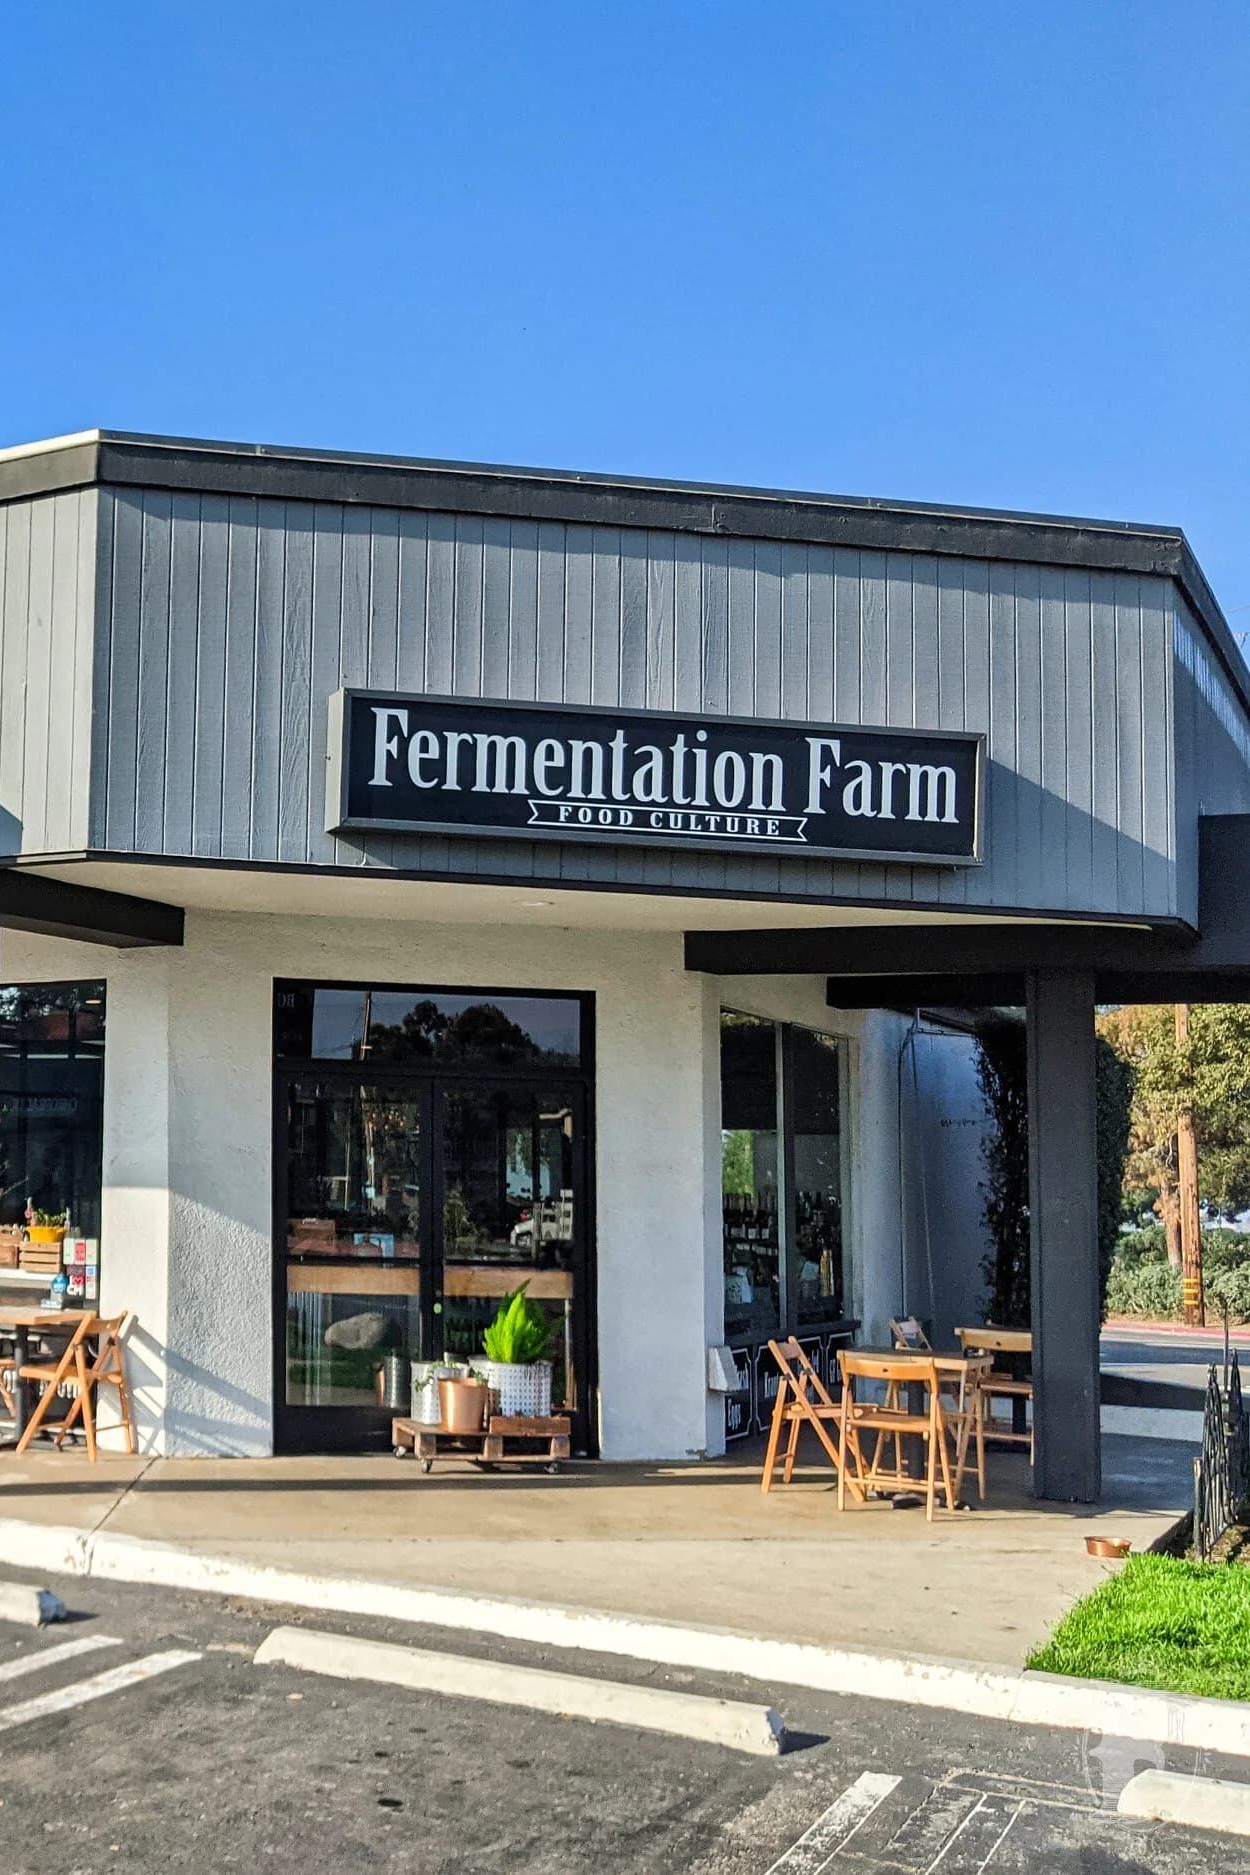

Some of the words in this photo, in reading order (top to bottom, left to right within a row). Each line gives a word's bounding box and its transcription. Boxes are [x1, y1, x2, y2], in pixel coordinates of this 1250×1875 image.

[368, 706, 784, 813] Fermentation
[803, 736, 960, 824] Farm
[558, 805, 635, 827] FOOD
[649, 811, 781, 836] CULTURE
